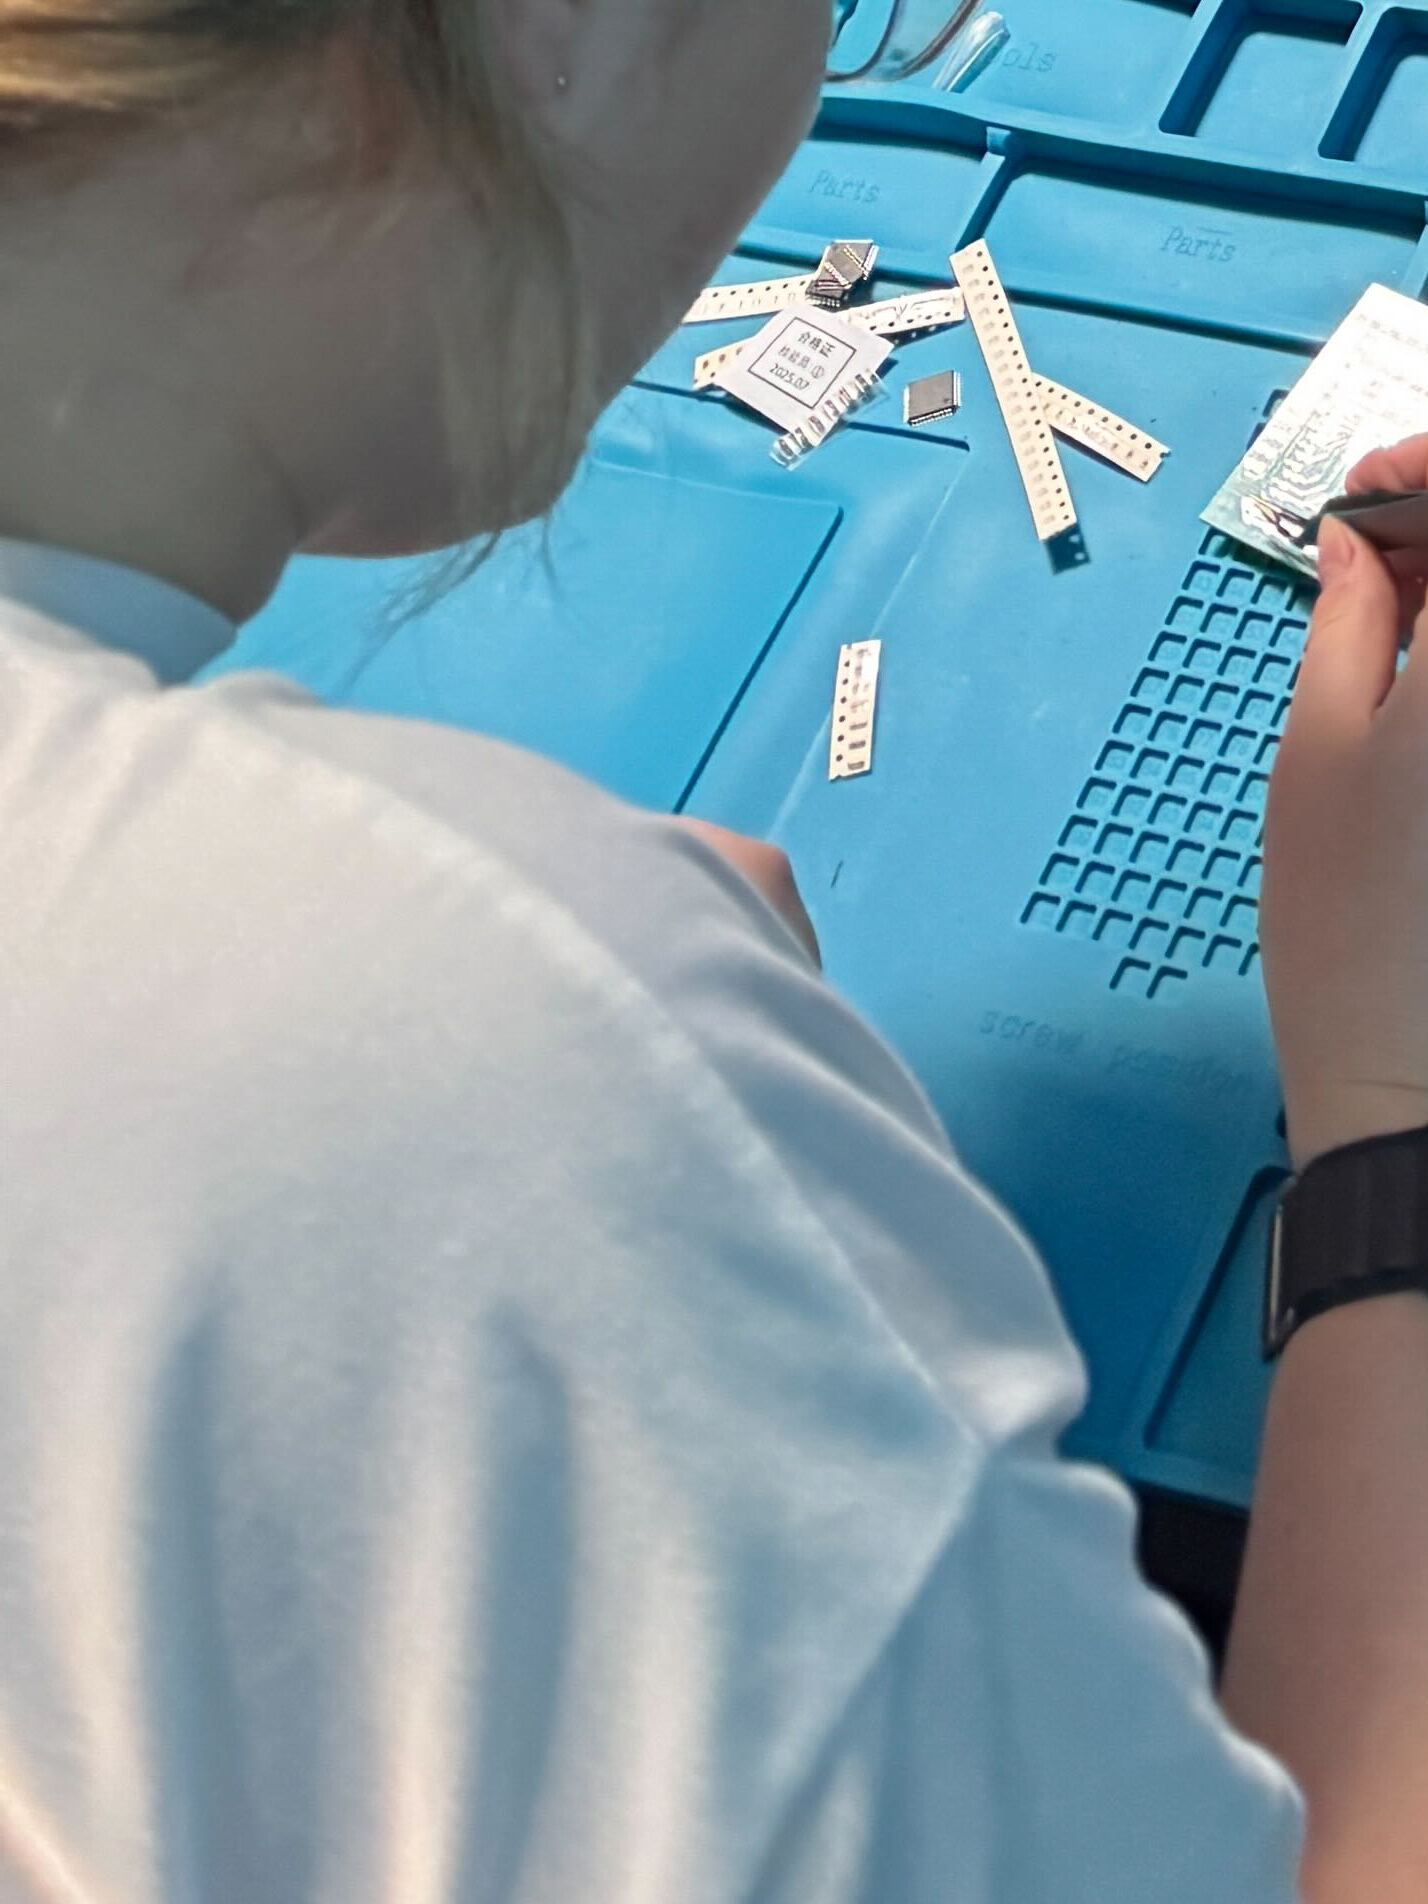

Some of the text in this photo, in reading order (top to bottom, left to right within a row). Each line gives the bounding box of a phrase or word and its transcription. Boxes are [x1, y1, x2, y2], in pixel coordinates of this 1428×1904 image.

[808, 168, 881, 204] Parts
[1160, 225, 1238, 262] Parts
[797, 330, 837, 359] 合格证
[769, 362, 811, 391] 2025.07
[979, 1008, 1085, 1055] screw
